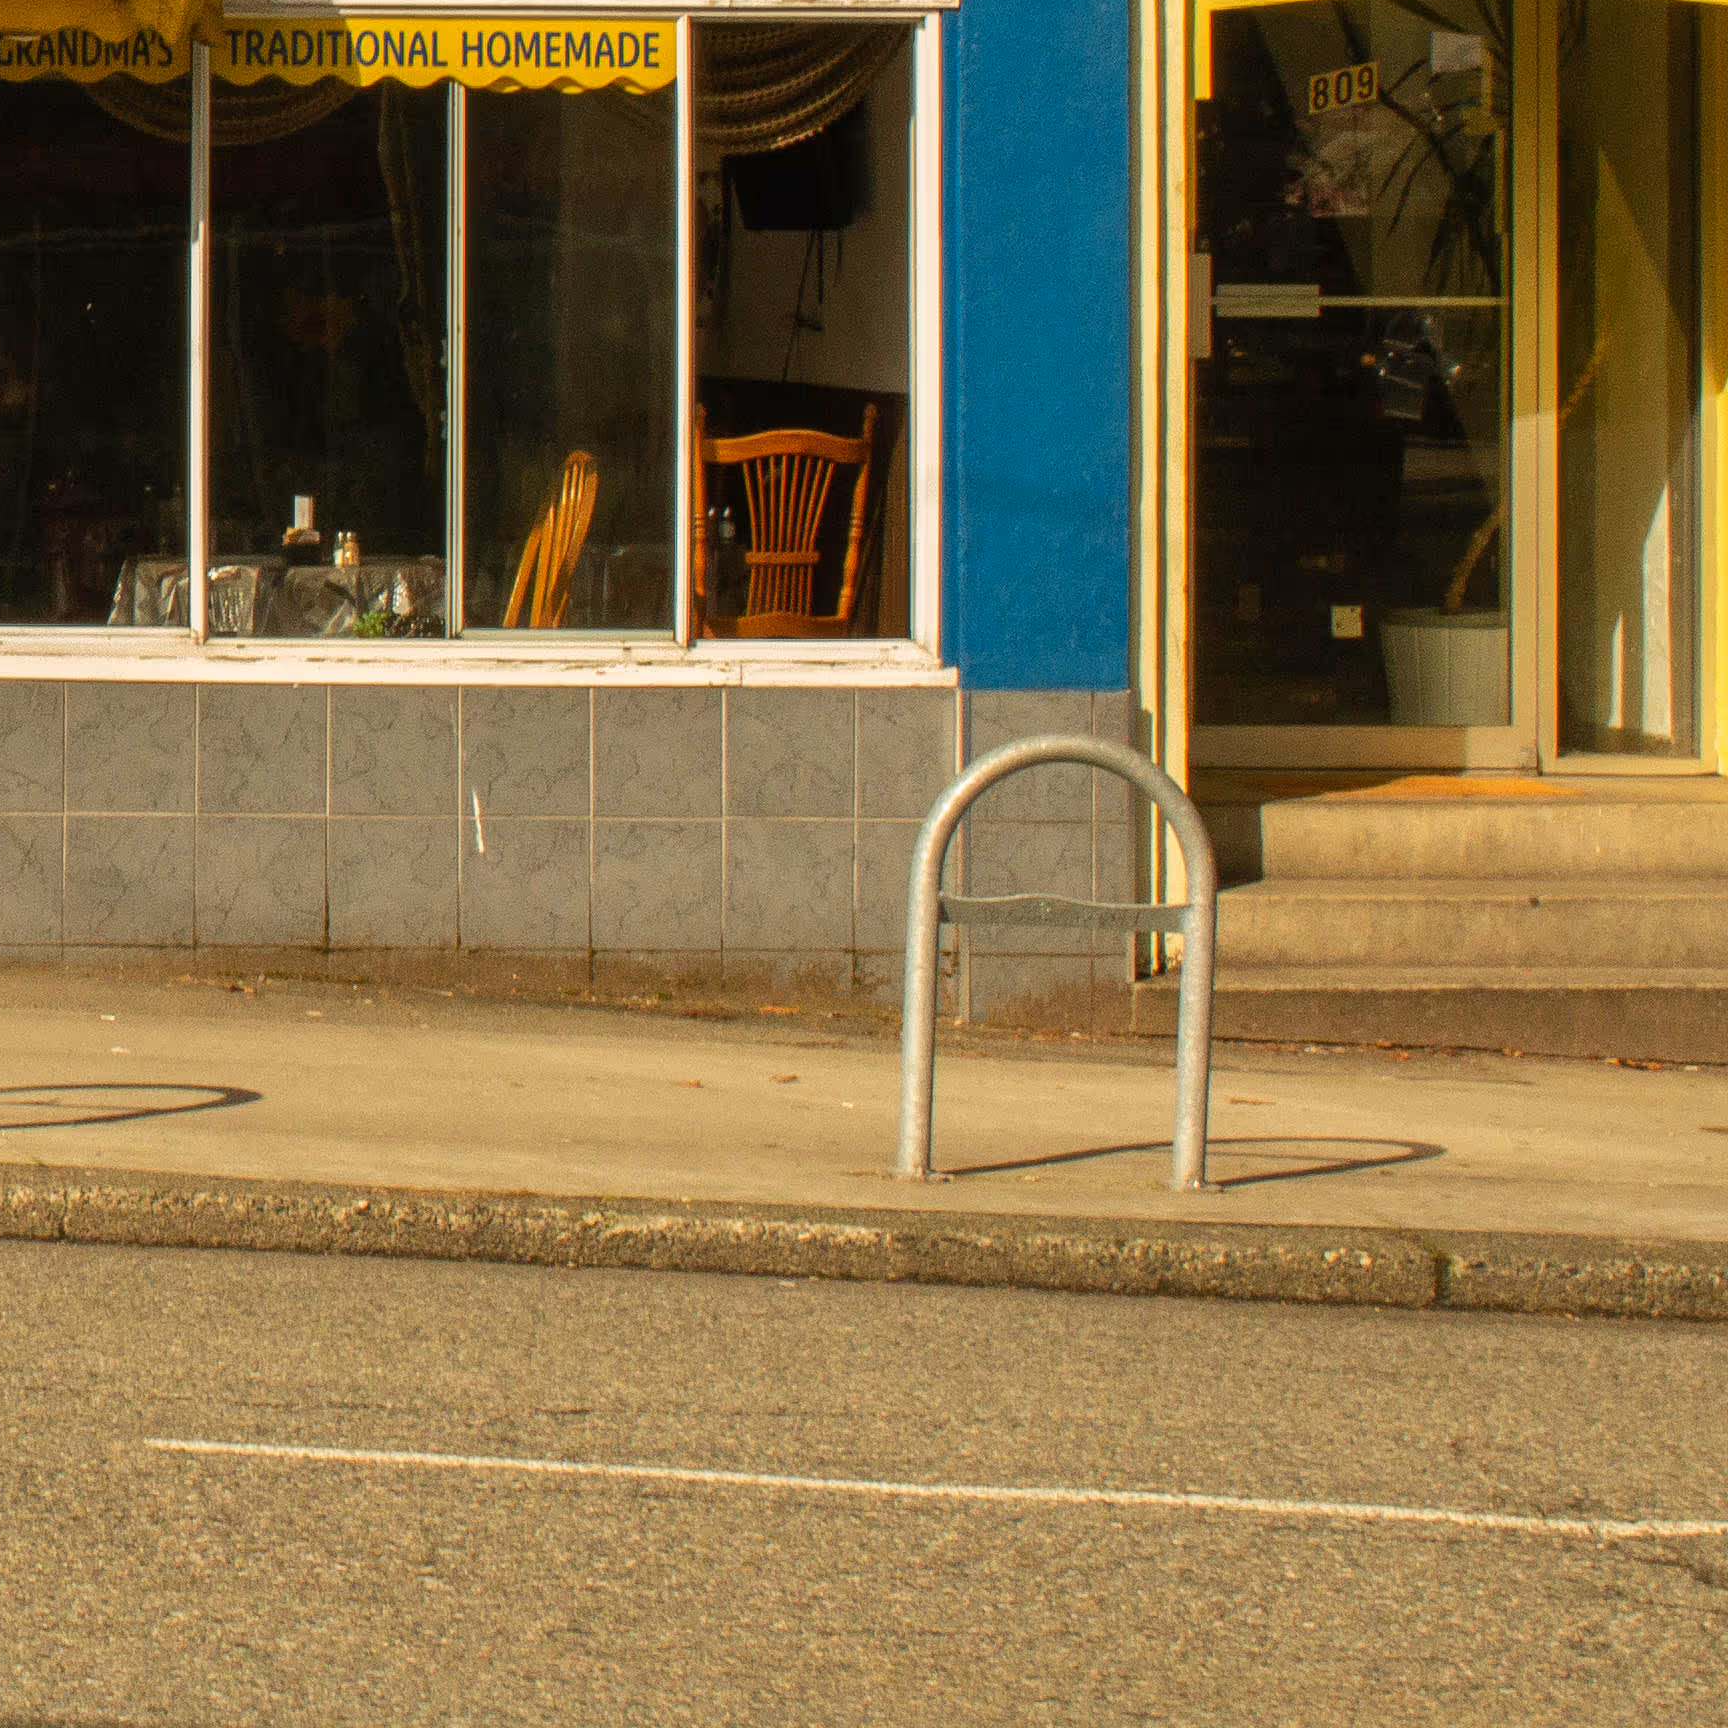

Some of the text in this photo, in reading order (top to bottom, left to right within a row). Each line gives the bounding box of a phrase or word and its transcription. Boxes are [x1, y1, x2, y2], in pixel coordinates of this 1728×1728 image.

[228, 30, 447, 69] TRADITIONAL
[462, 31, 661, 70] HOMEMADE
[1313, 67, 1374, 110] 809
